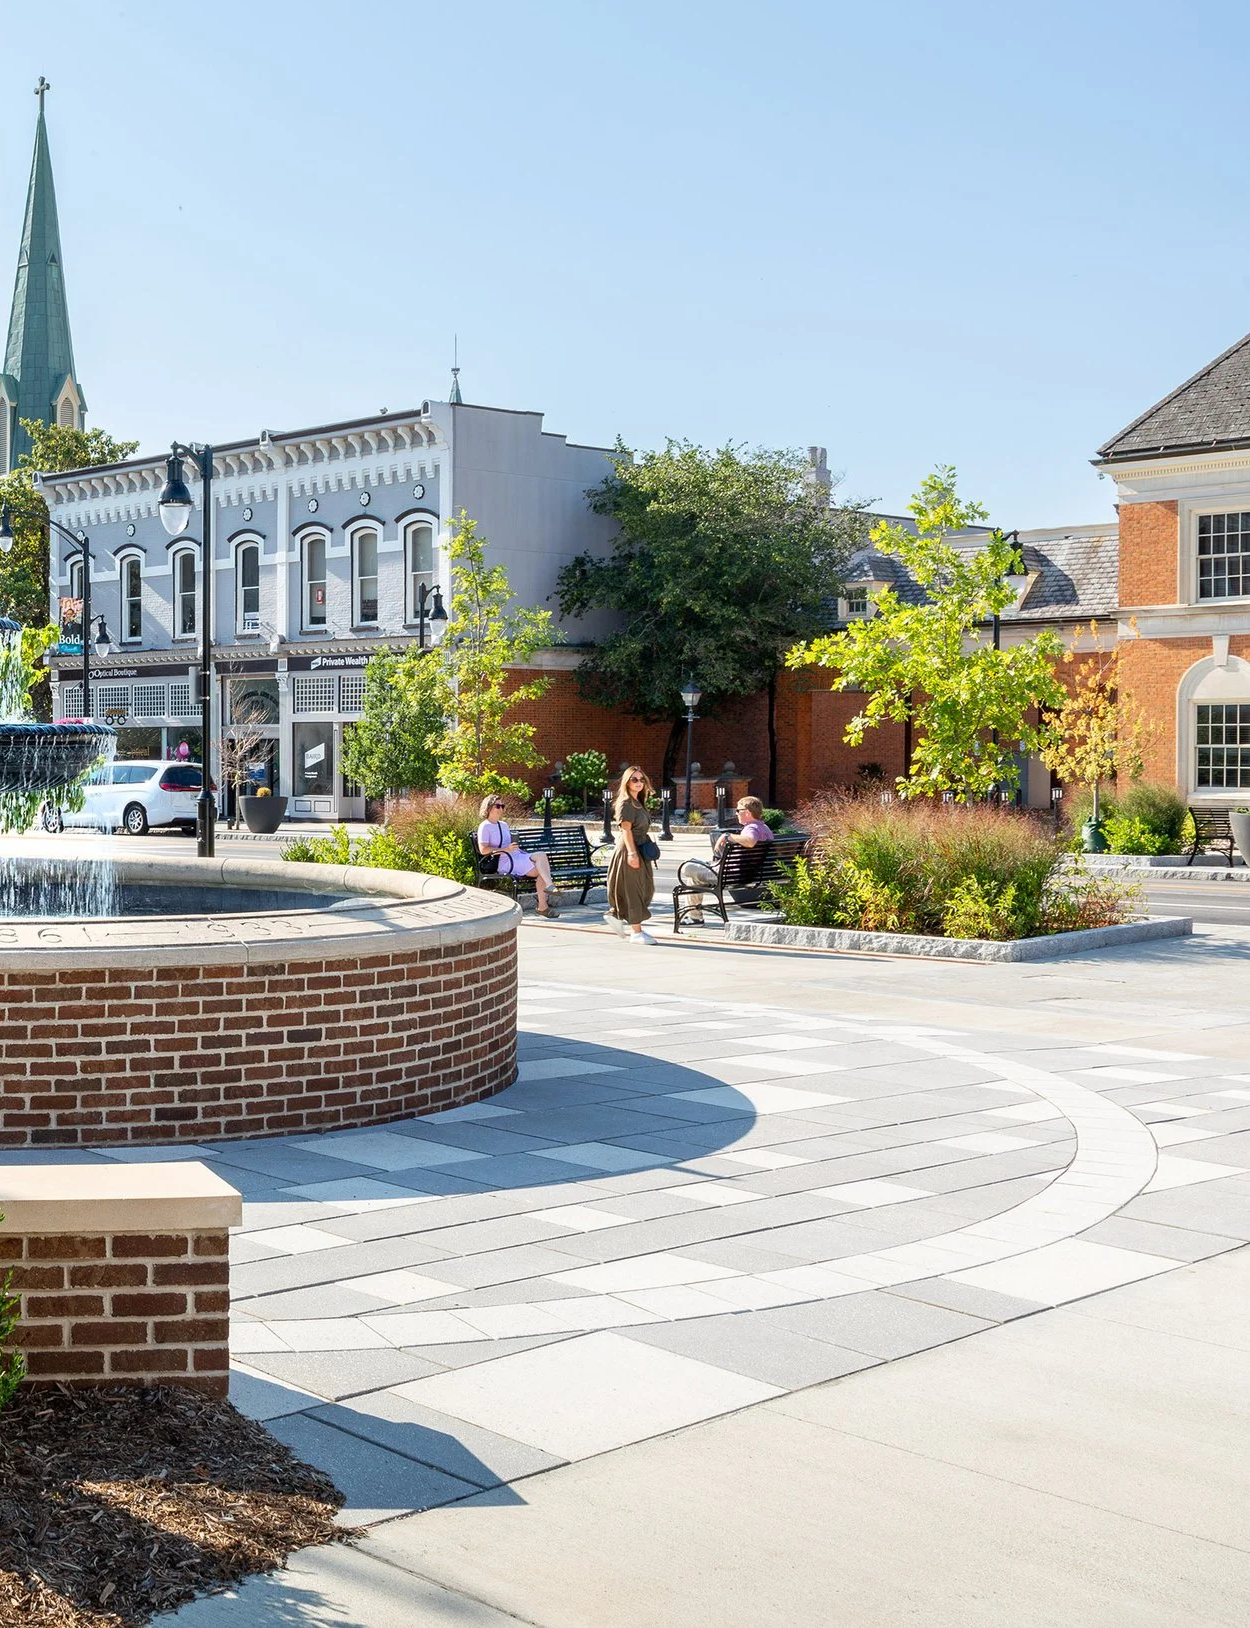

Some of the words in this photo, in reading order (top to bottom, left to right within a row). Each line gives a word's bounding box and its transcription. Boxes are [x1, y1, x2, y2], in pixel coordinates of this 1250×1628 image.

[59, 634, 80, 645] Bold
[322, 657, 345, 667] Private
[345, 656, 368, 666] Wealth
